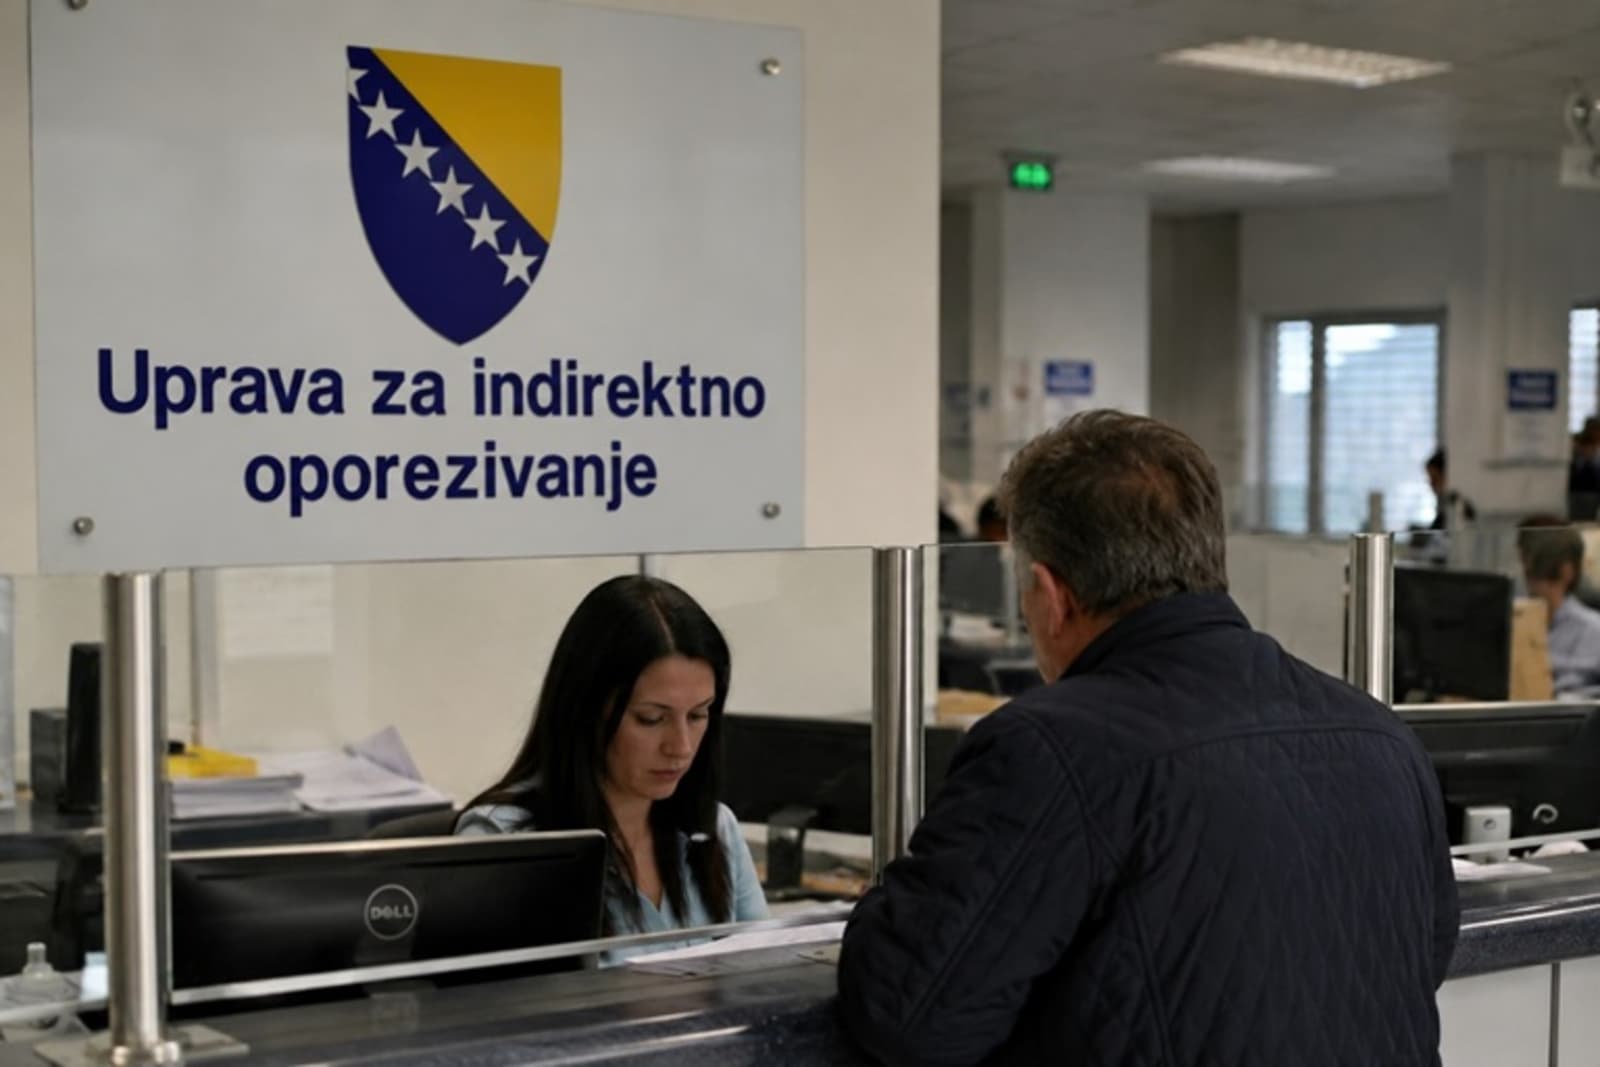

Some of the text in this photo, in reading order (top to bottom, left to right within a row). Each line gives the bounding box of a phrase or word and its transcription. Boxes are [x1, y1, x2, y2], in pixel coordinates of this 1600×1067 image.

[97, 348, 766, 430] Uprava za indirektno
[243, 440, 657, 518] oporezivanje
